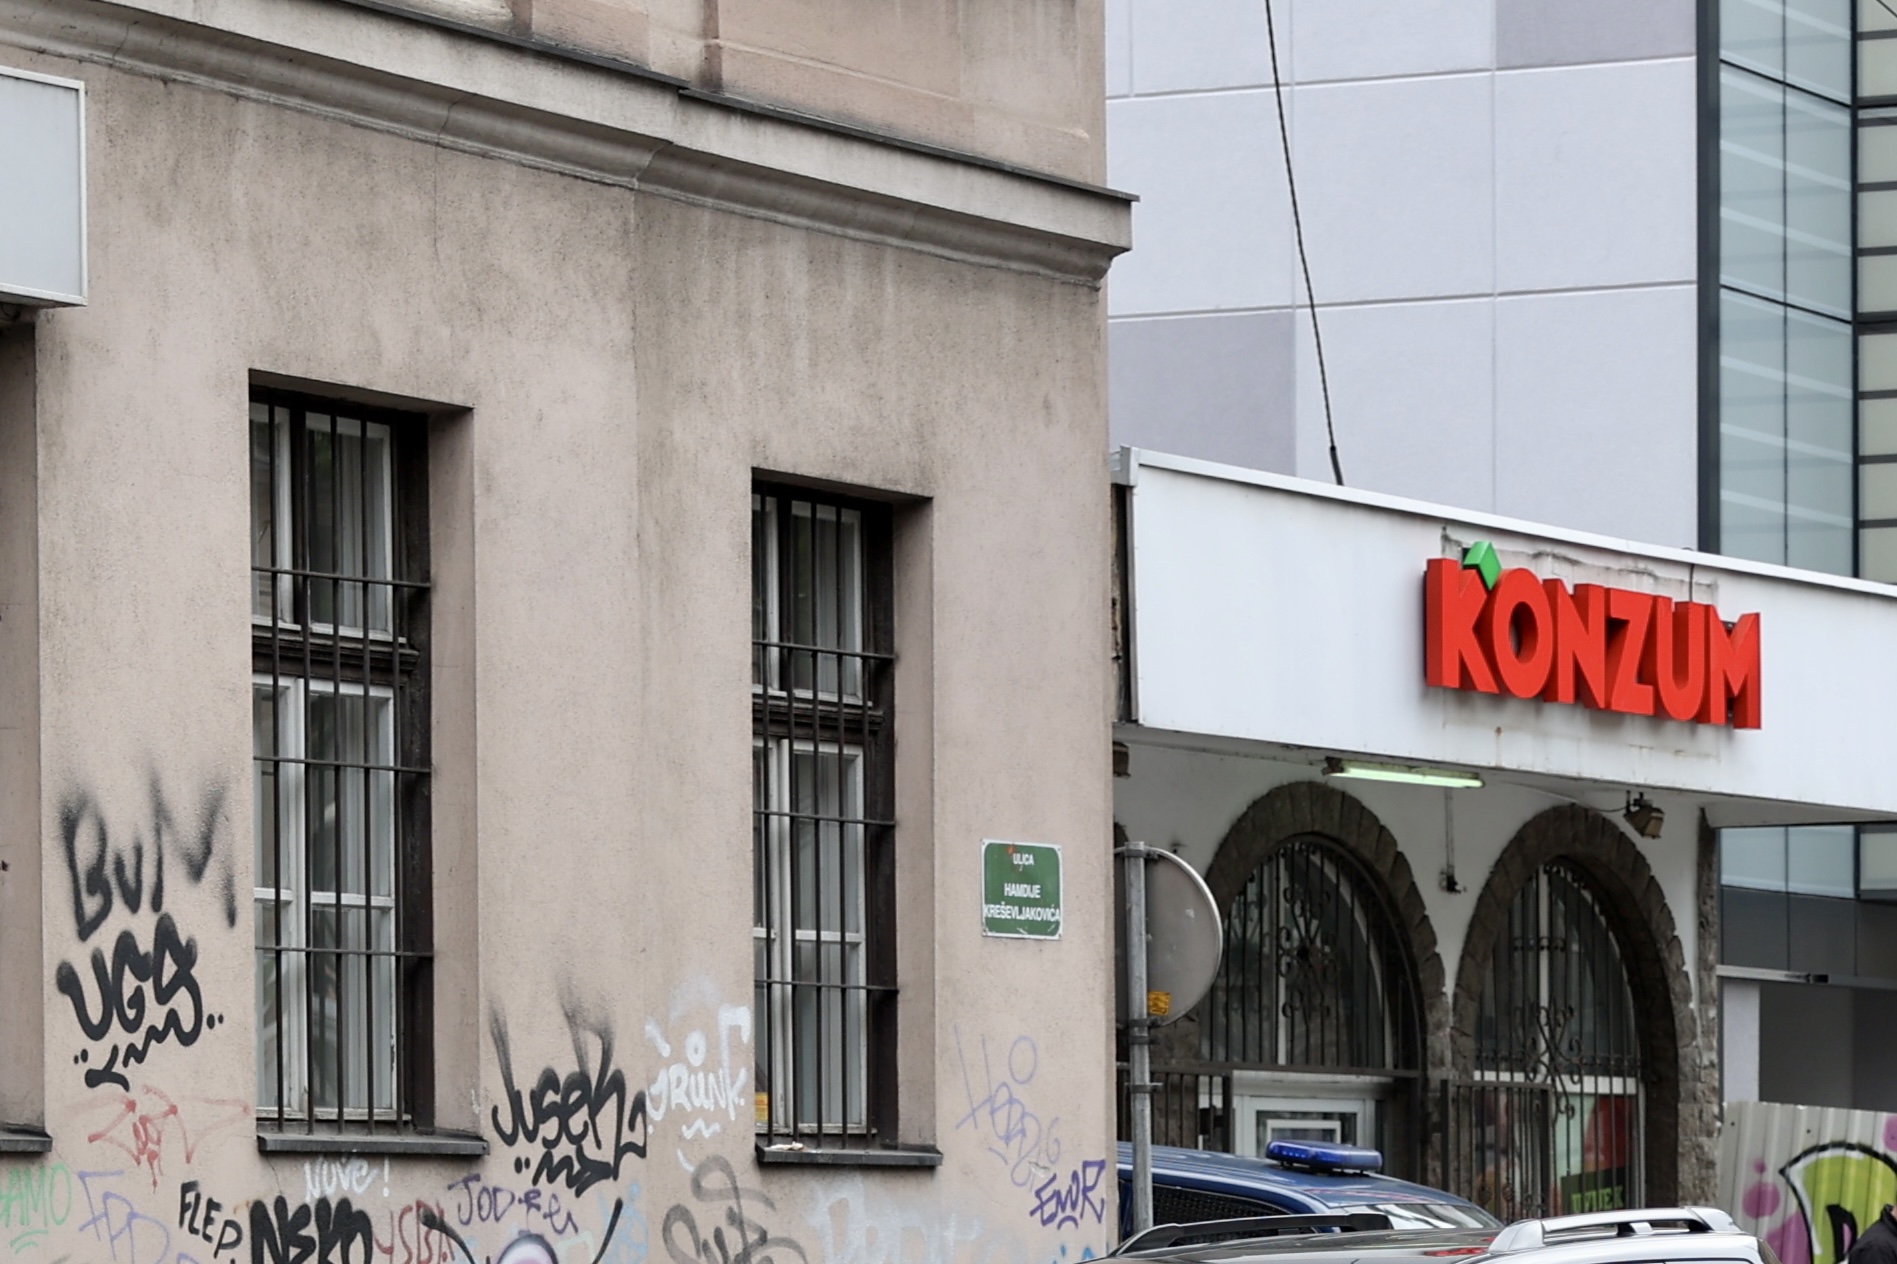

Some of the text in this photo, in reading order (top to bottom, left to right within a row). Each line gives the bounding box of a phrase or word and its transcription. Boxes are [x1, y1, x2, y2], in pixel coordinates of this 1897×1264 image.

[1426, 556, 1762, 730] KONZUM
[1013, 853, 1035, 865] ULICA
[1004, 882, 1041, 899] HAMDIJE
[984, 901, 1060, 922] KREŠEVLJAKOVIĆA
